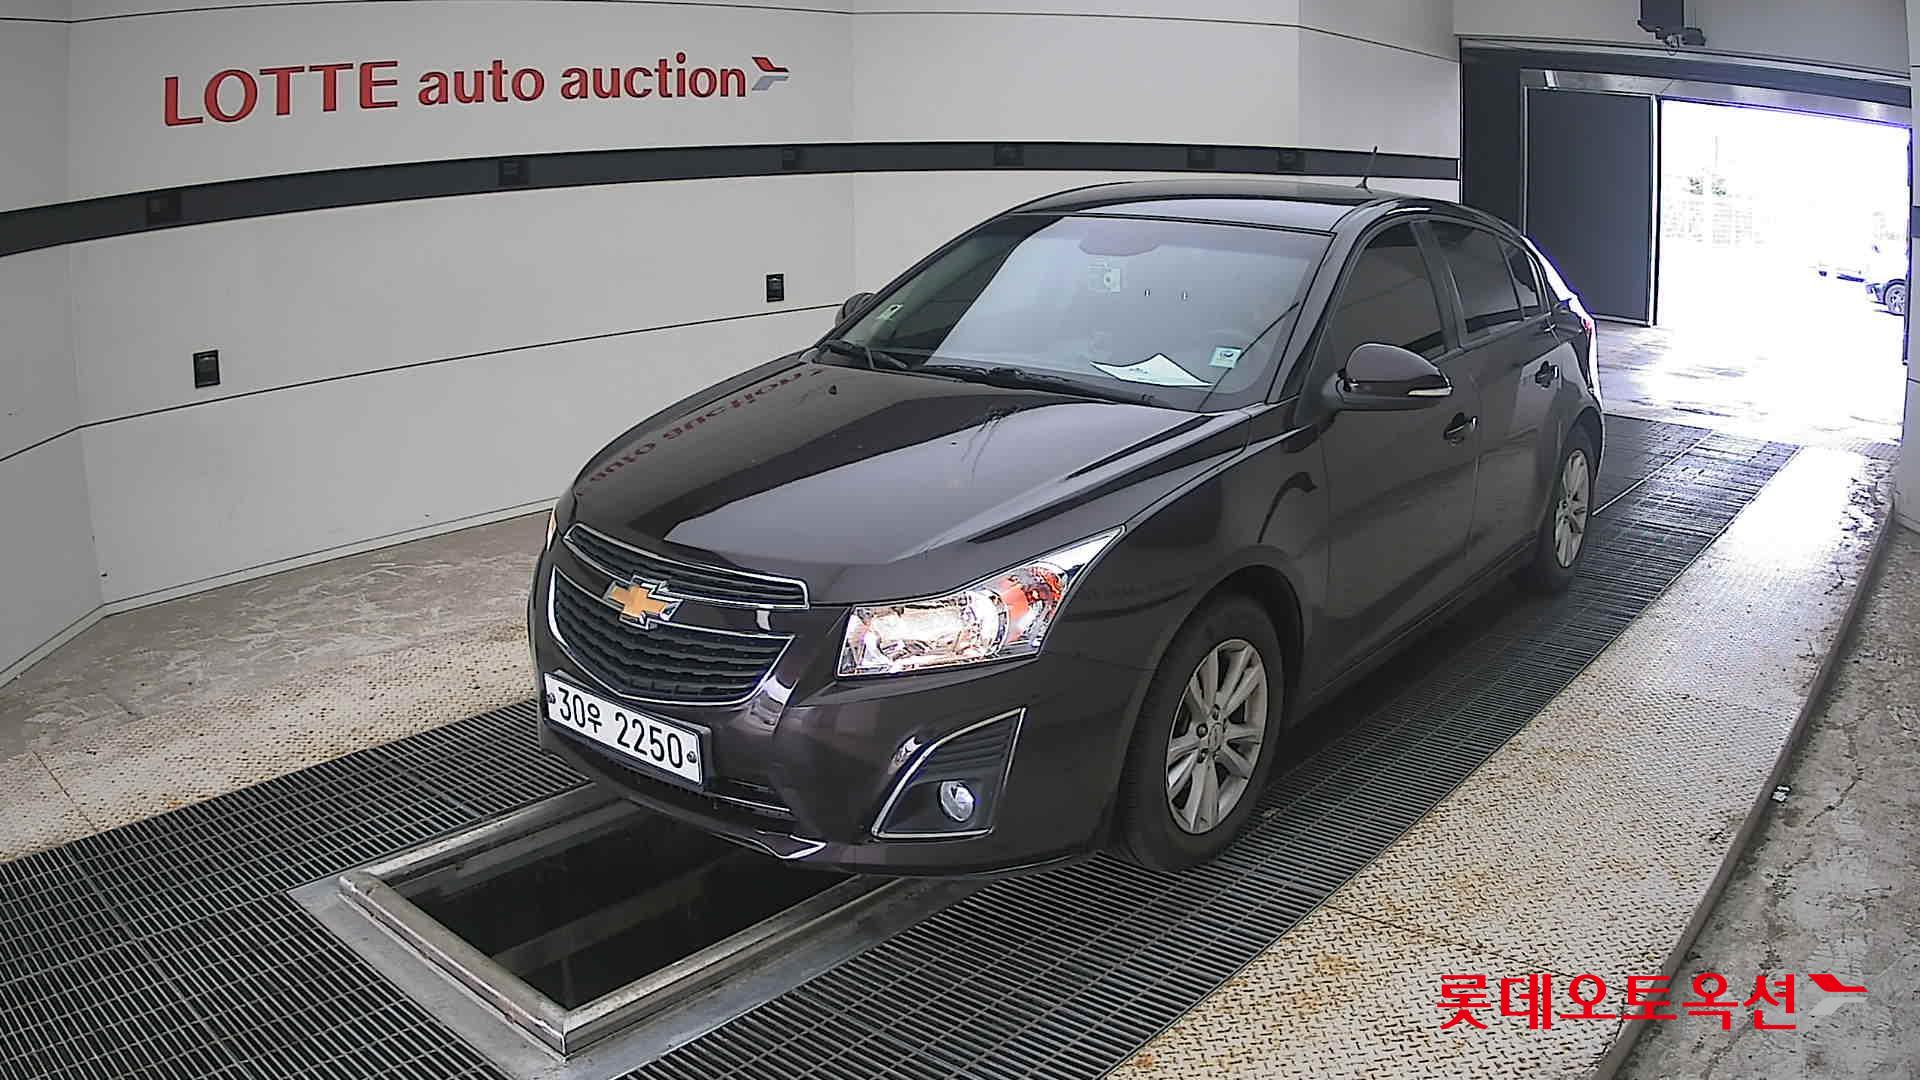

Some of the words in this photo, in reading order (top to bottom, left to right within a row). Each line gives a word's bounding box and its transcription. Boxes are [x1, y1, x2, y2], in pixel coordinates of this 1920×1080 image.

[163, 60, 400, 127] LOTTE
[417, 60, 546, 106] auto
[560, 51, 748, 100] auction
[558, 686, 603, 734] 30우
[615, 711, 684, 769] 2250
